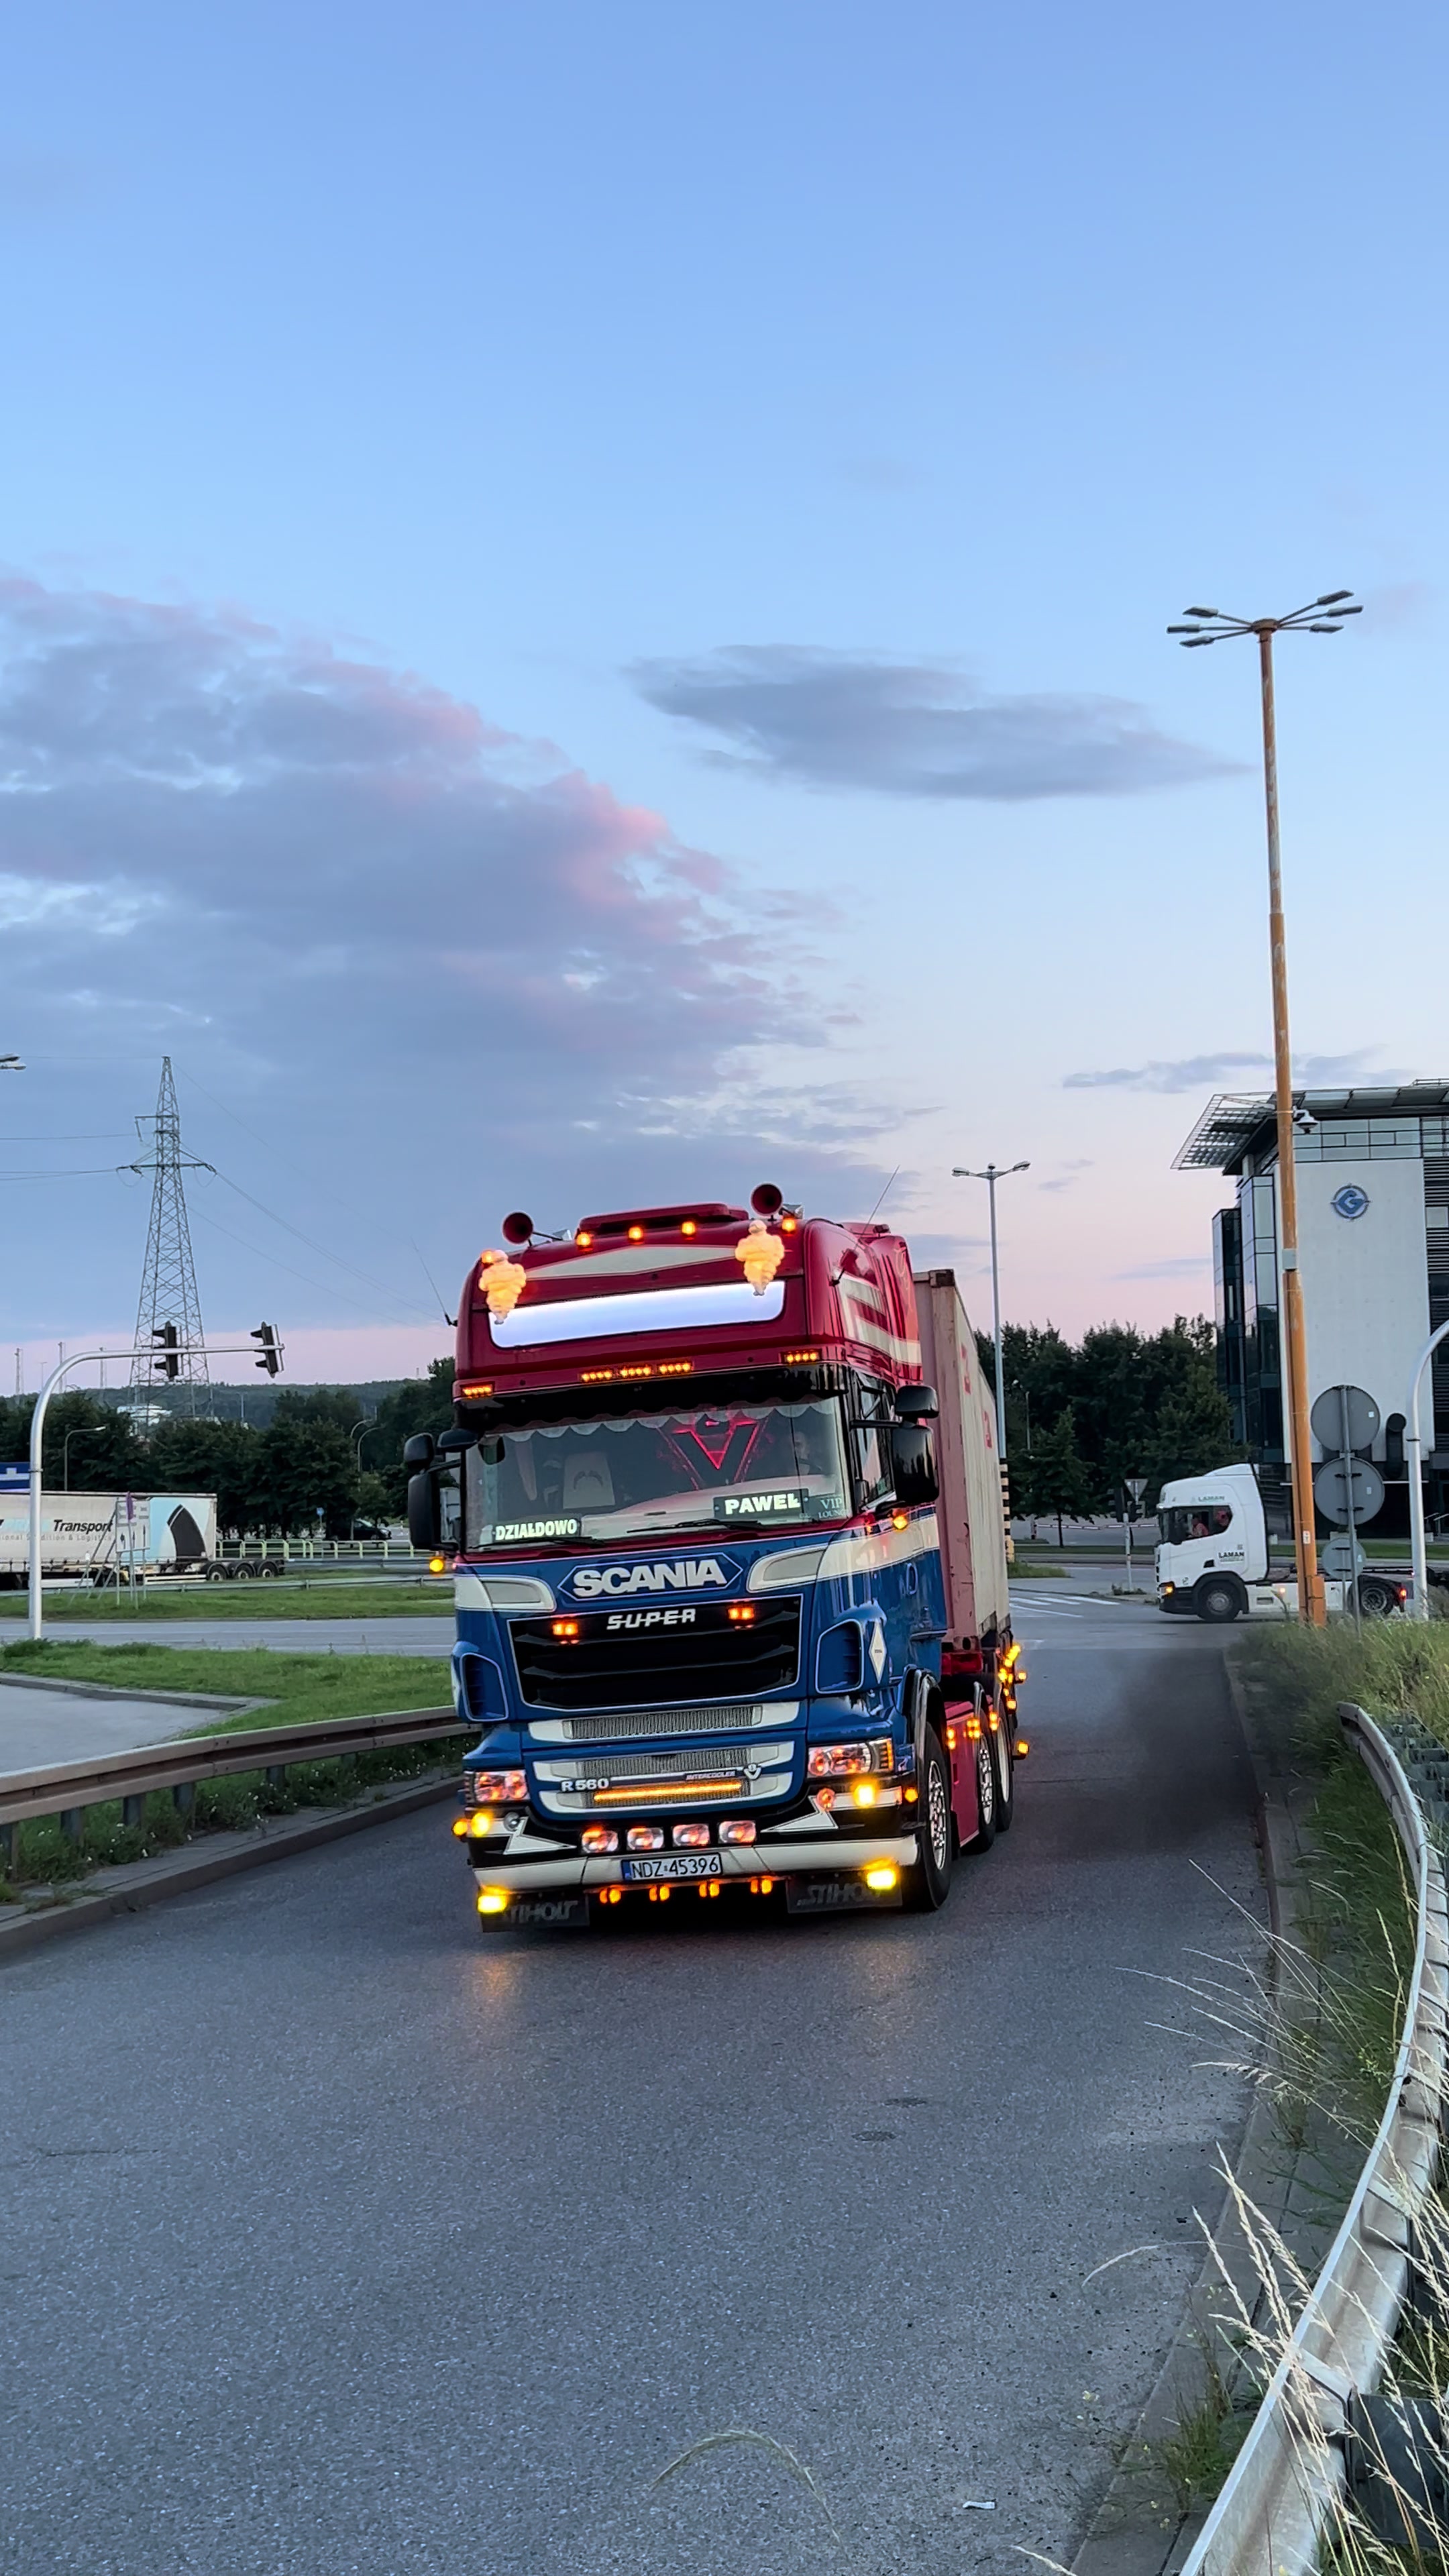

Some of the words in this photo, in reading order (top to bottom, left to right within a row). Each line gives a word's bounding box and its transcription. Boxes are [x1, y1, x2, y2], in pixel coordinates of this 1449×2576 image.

[724, 1493, 800, 1515] PAWEŁ
[820, 1497, 843, 1509] VIP
[54, 1519, 113, 1535] Transport
[494, 1519, 578, 1540] DZIAŁDOWO
[573, 1558, 727, 1597] SCANIA
[606, 1609, 696, 1630] SUPER
[561, 1781, 574, 1792] R
[632, 1861, 663, 1878] NDZ
[669, 1857, 719, 1875] 45396
